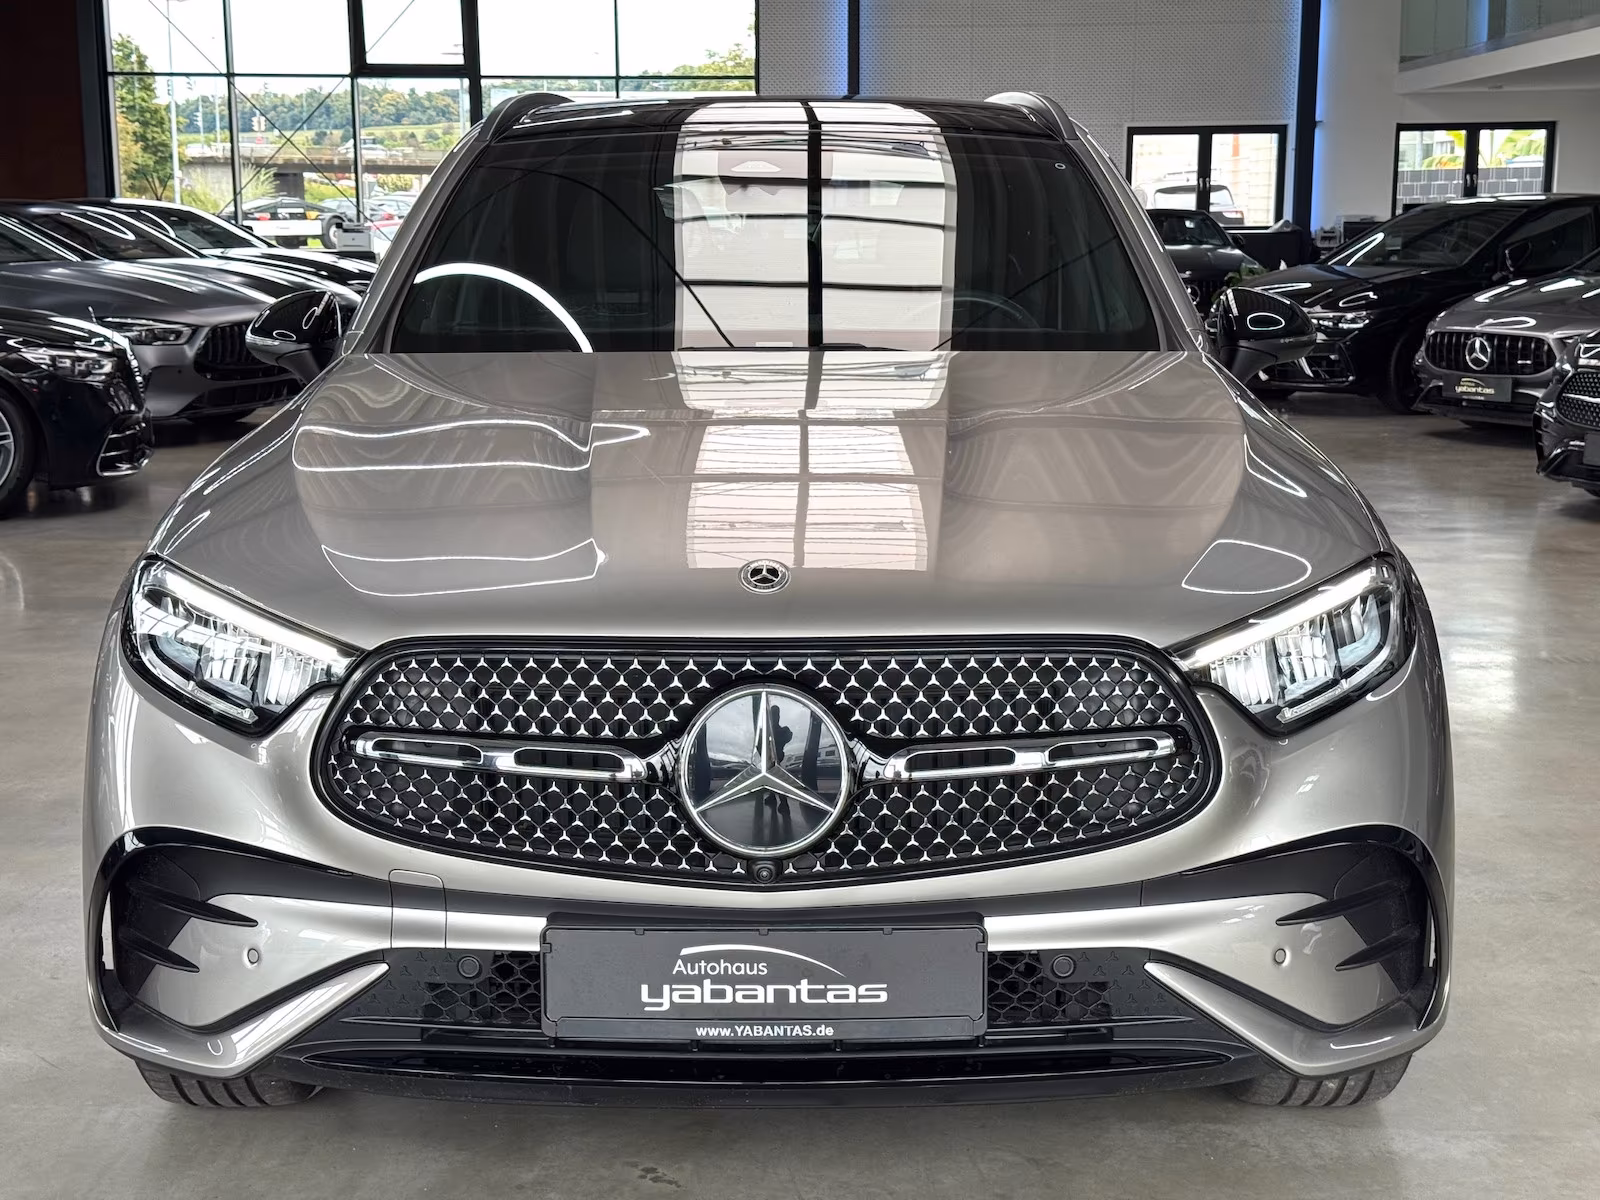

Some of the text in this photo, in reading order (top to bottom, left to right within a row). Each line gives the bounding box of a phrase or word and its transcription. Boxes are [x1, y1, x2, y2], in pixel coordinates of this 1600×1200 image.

[672, 958, 768, 976] Autohaus
[640, 978, 888, 1012] yabantas
[695, 1024, 835, 1037] www.YABANTAS.de
